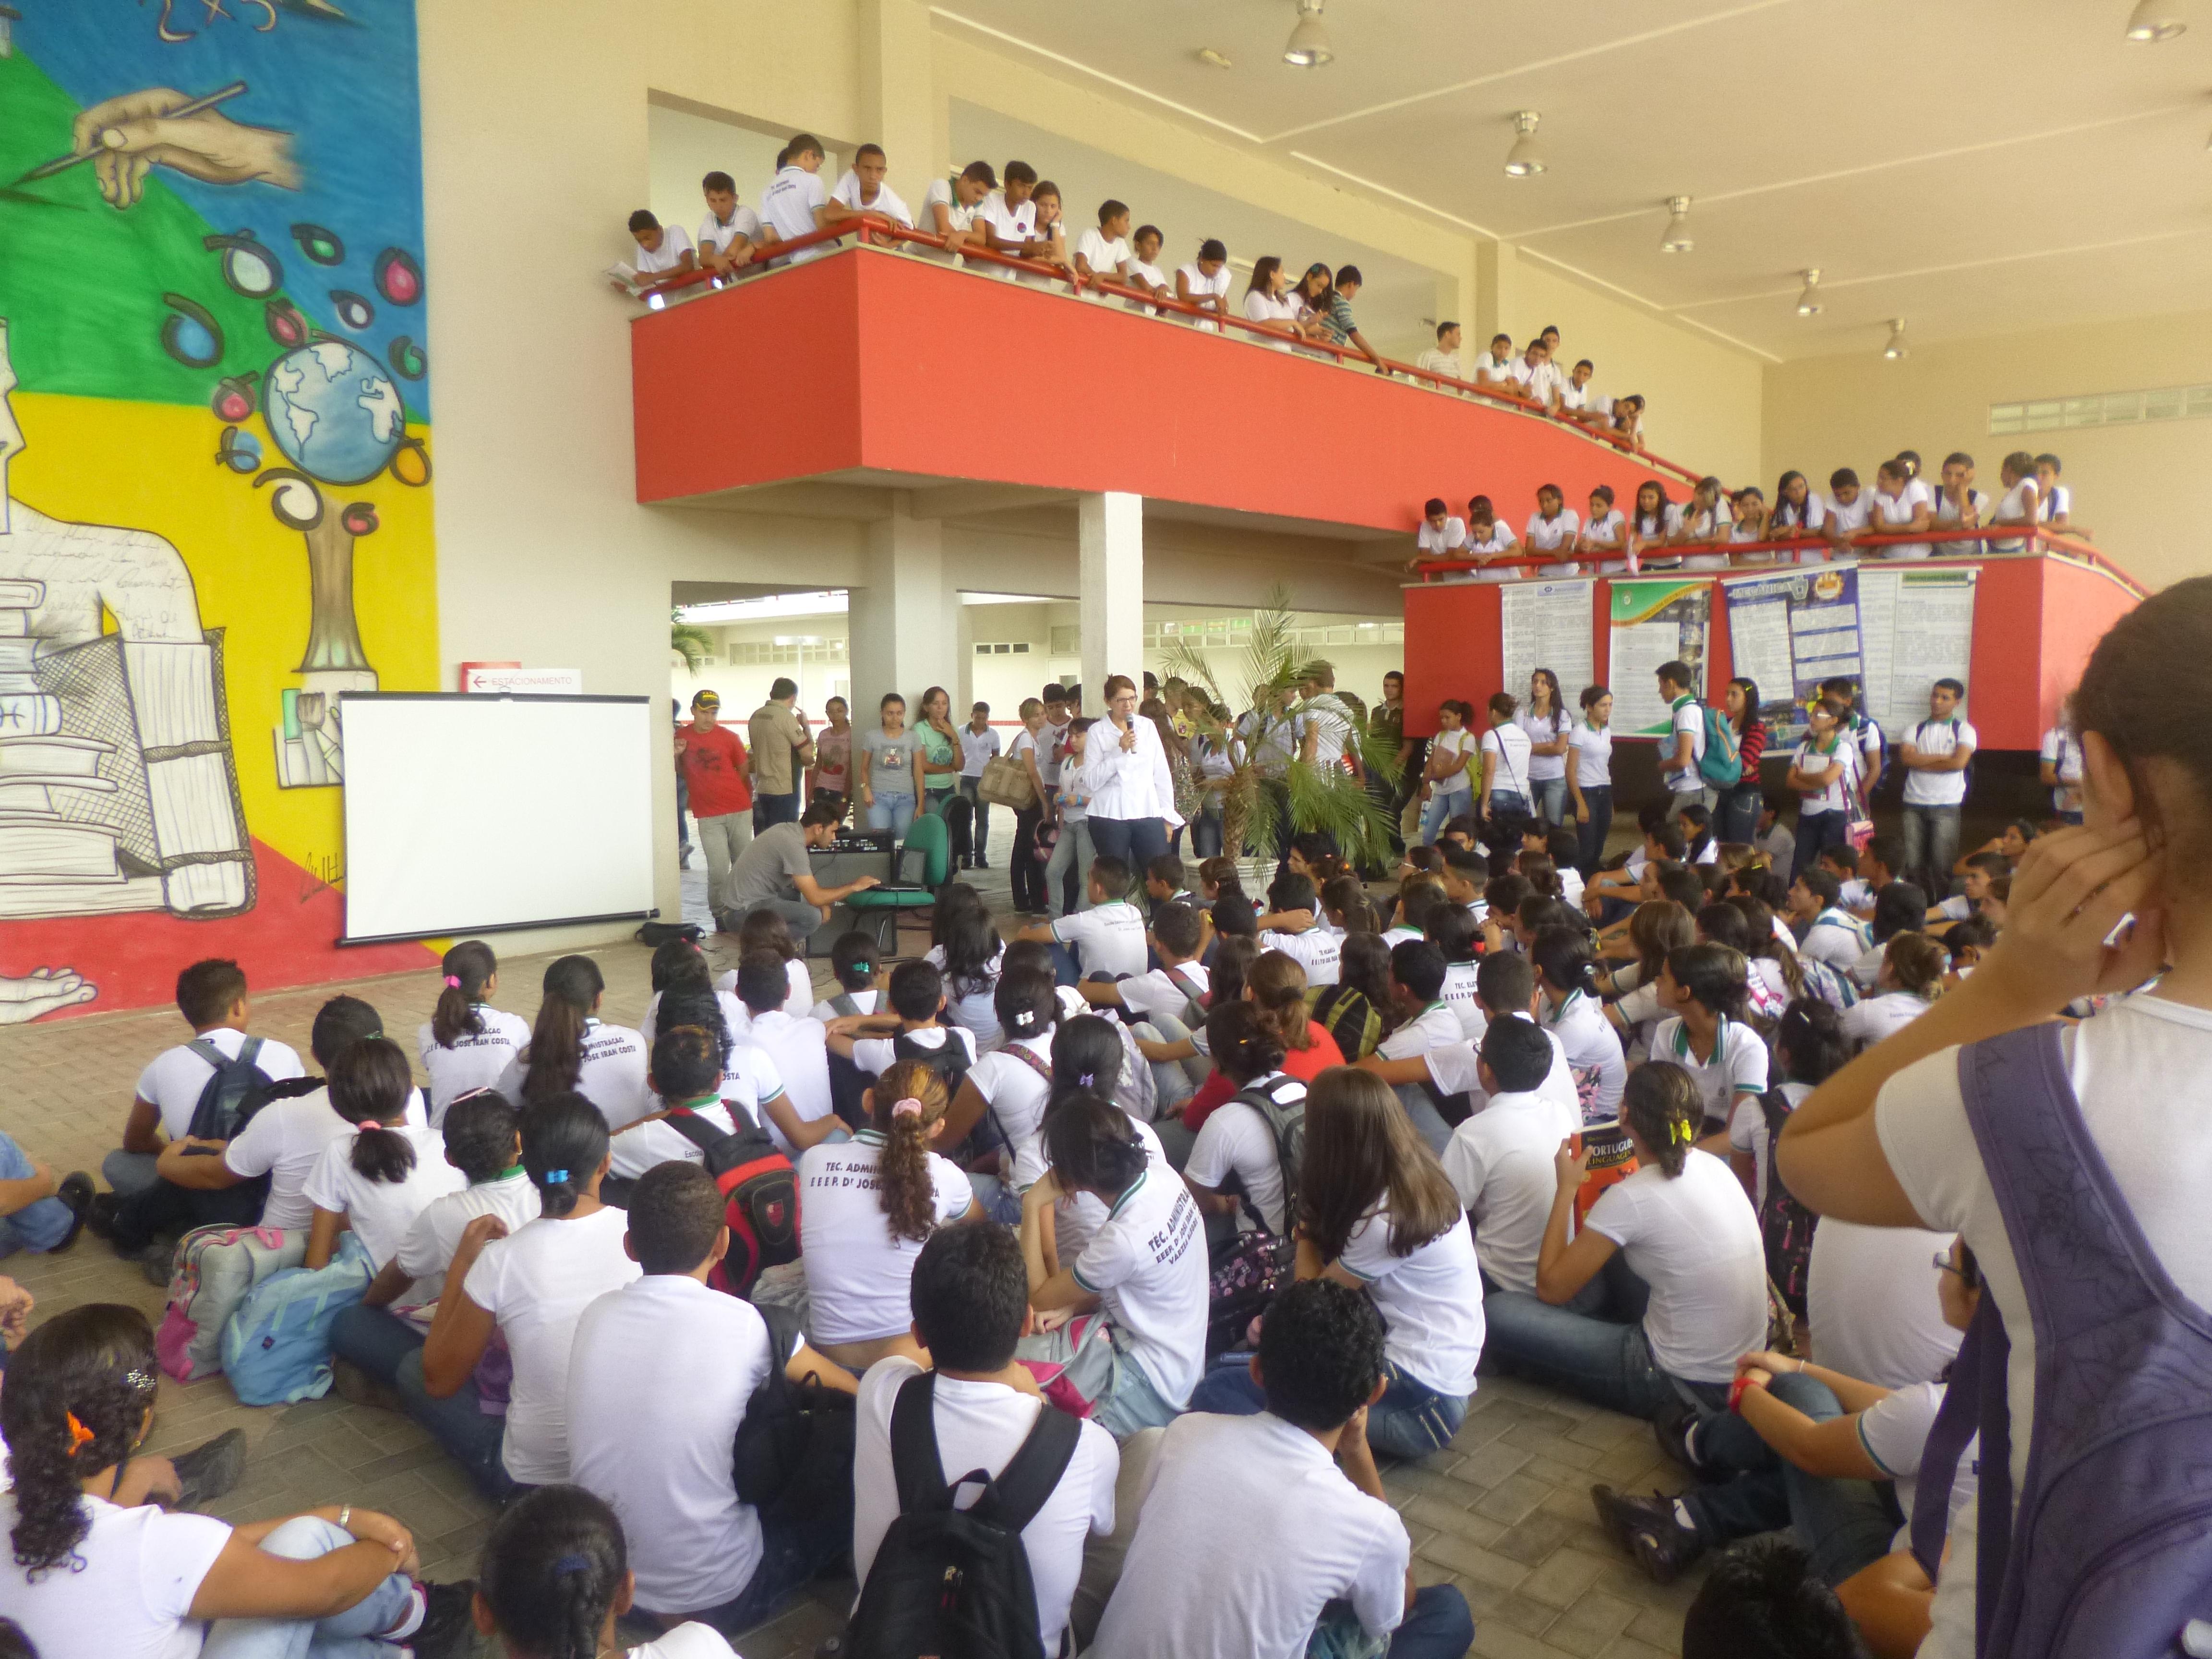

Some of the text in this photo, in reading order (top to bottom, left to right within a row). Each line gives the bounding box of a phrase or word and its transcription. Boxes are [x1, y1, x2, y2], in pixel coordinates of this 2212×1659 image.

[492, 677, 572, 686] ESTACIONAMENTO
[492, 1037, 510, 1046] COSTA
[601, 1048, 618, 1058] IRAN
[619, 1045, 636, 1054] COSTA
[826, 1162, 843, 1171] TEC.
